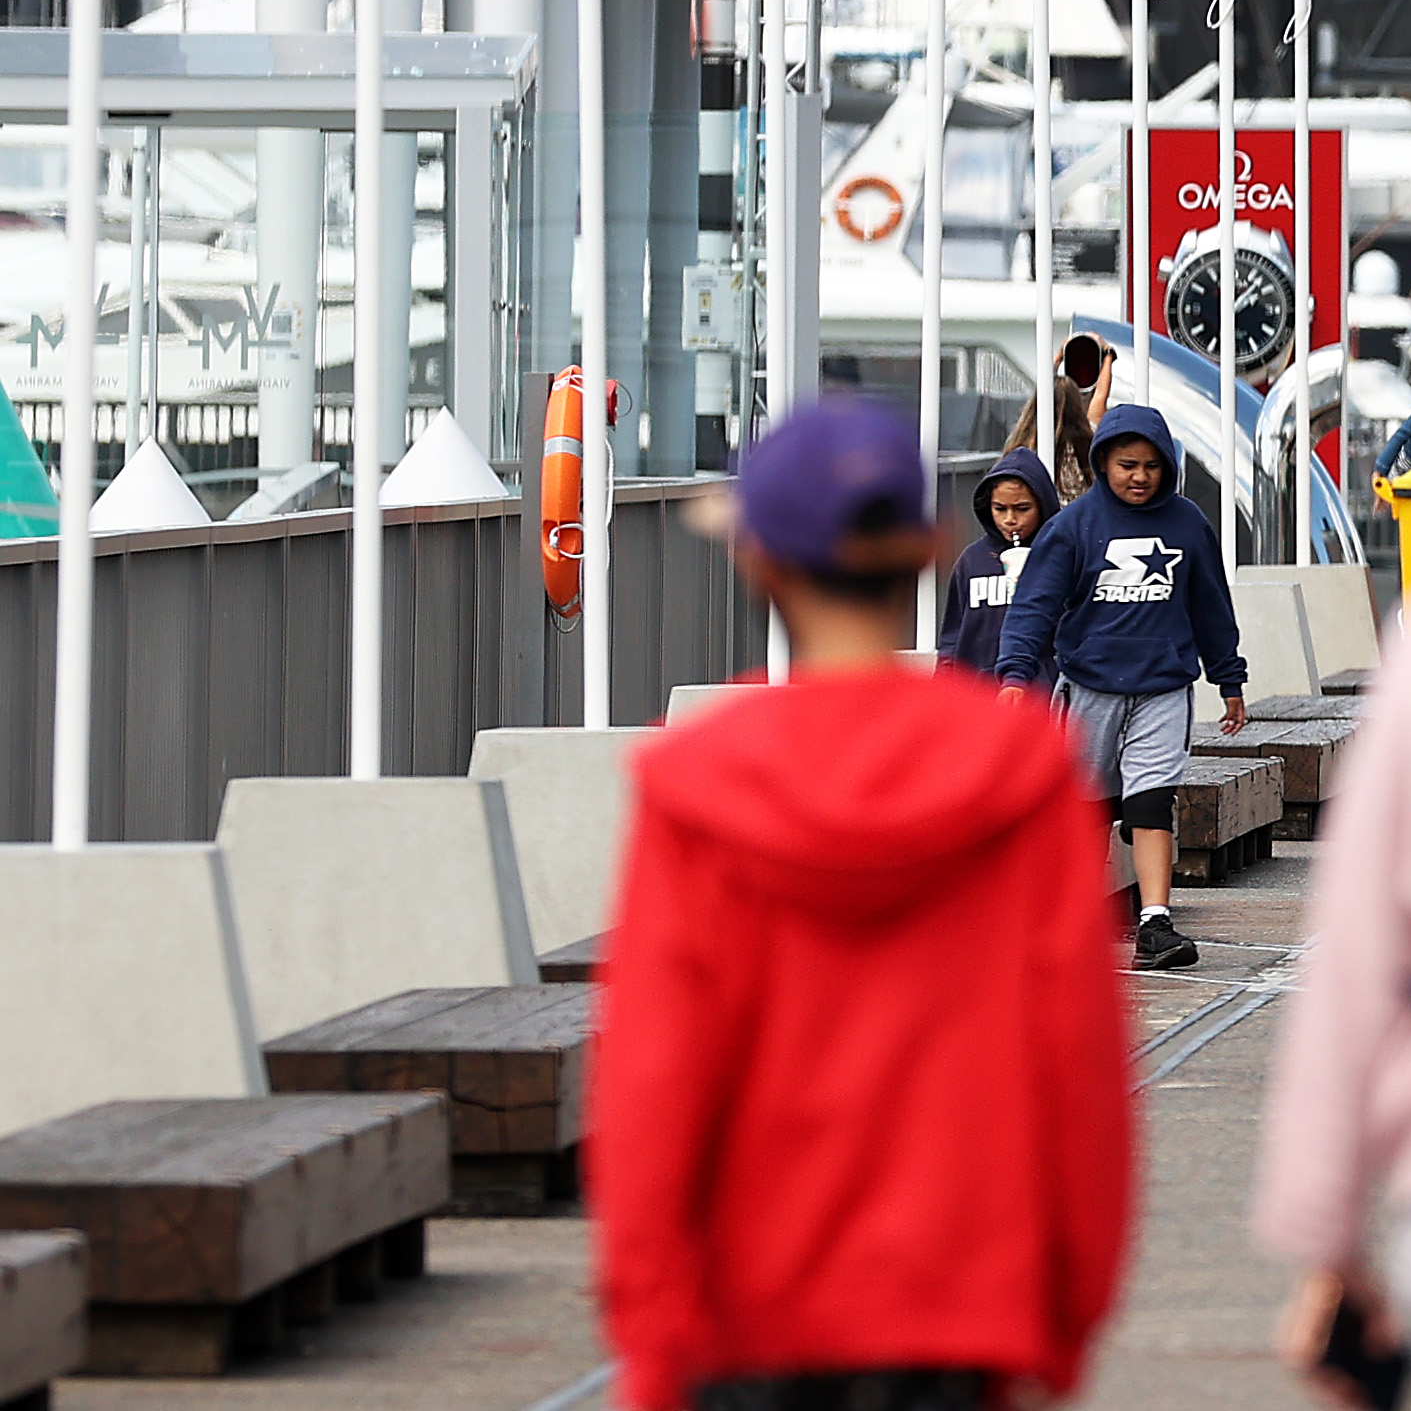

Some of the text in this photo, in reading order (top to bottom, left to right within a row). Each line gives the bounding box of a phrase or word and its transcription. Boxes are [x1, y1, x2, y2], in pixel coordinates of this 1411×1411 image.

[1177, 182, 1294, 211] OMEGA
[970, 575, 1013, 609] PU
[1092, 584, 1174, 603] STARTER
